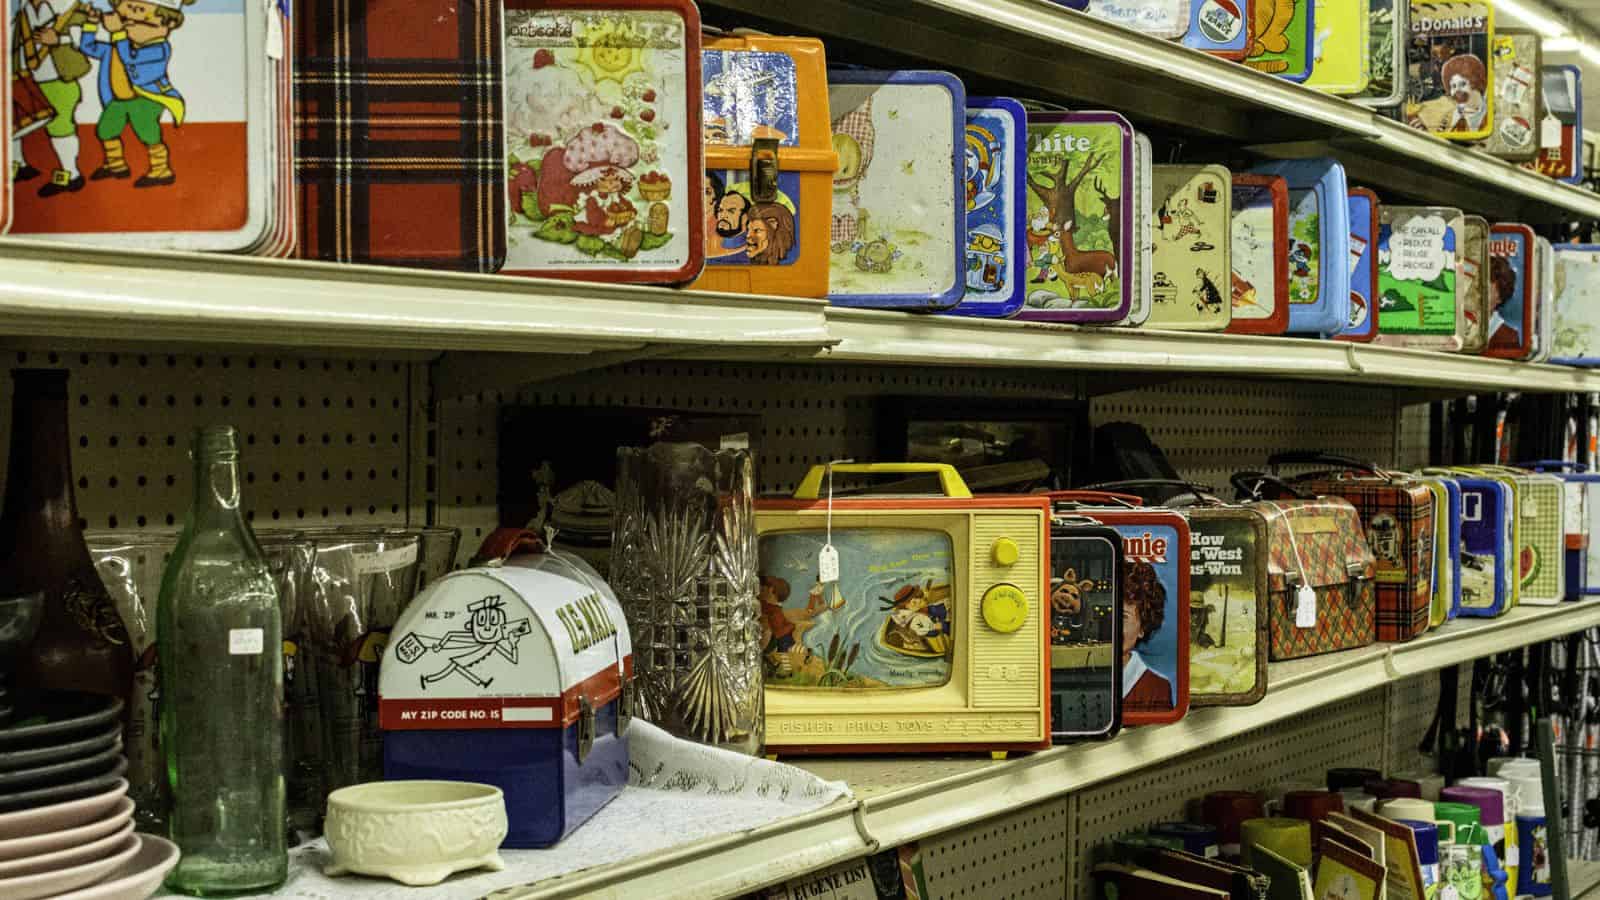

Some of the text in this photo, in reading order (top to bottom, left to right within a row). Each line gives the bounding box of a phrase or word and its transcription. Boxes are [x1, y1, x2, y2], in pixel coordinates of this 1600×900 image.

[1028, 133, 1090, 152] hite
[1190, 532, 1224, 546] How
[1201, 547, 1243, 561] West
[1204, 561, 1242, 576] Won
[443, 611, 456, 619] ZIP
[401, 711, 417, 720] MY
[420, 710, 438, 719] ZIP
[440, 709, 467, 719] CODE
[490, 709, 500, 719] IS
